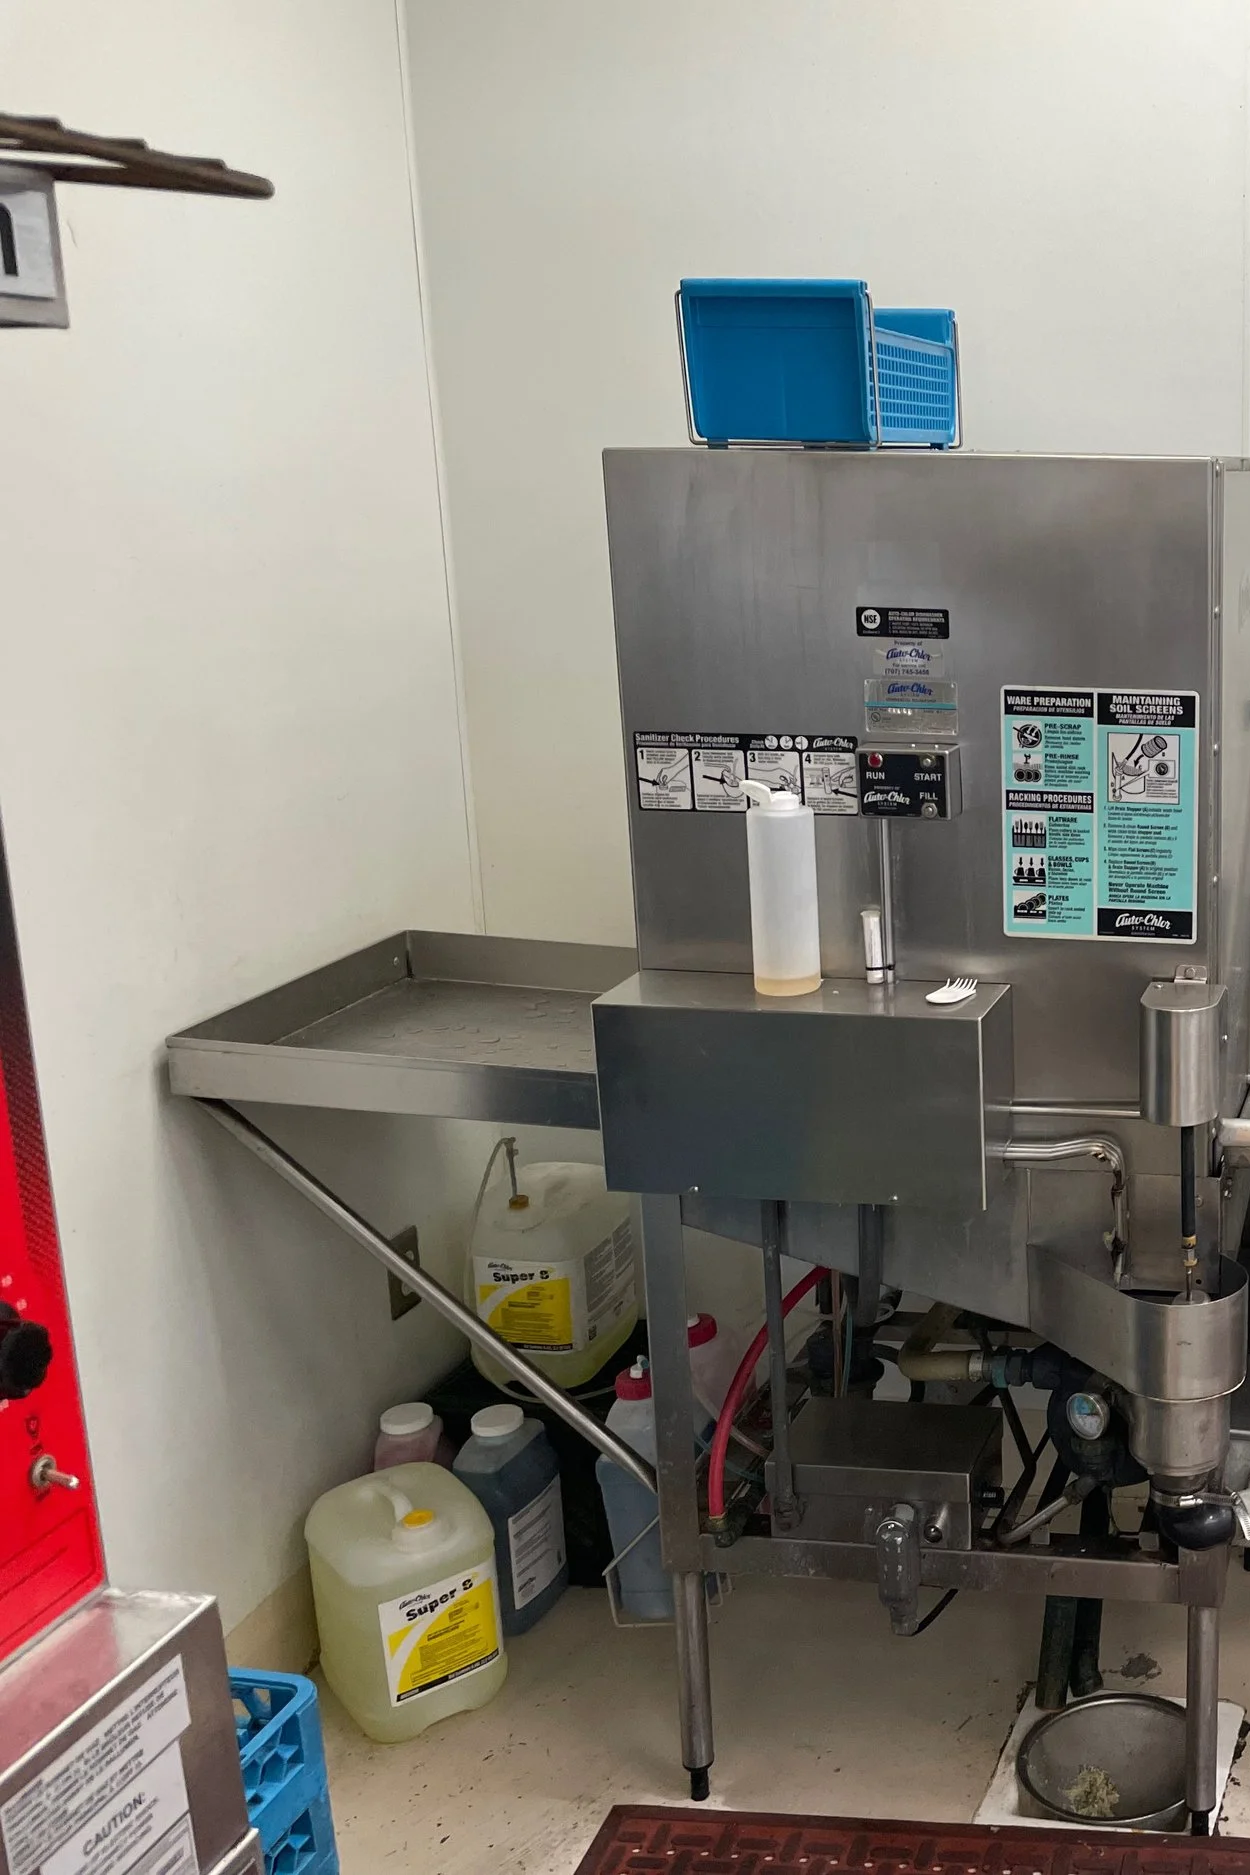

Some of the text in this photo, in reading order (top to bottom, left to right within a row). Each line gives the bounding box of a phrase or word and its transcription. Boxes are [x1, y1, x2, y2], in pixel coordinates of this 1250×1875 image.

[886, 648, 932, 661] Auto-Chlor
[888, 682, 934, 696] Auto-Chlor
[1007, 696, 1091, 707] WARE PREPARATION
[1112, 695, 1180, 706] MAINTAINING
[1110, 704, 1184, 714] SOIL SCREENS
[635, 733, 739, 744] Sanitizer Check Procedures
[813, 737, 854, 750] Auto-Chlor
[640, 750, 644, 760] 1
[694, 751, 700, 761] 2
[749, 752, 756, 763] 3
[805, 754, 811, 764] 4
[866, 772, 942, 782] RUN START
[864, 791, 911, 805] Auto-Chlor
[919, 792, 938, 800] FILL
[1009, 793, 1092, 804] RACKING PROCEDURES
[1116, 913, 1171, 929] Auto-Chlor
[493, 1272, 535, 1284] Super
[406, 1588, 457, 1622] Super
